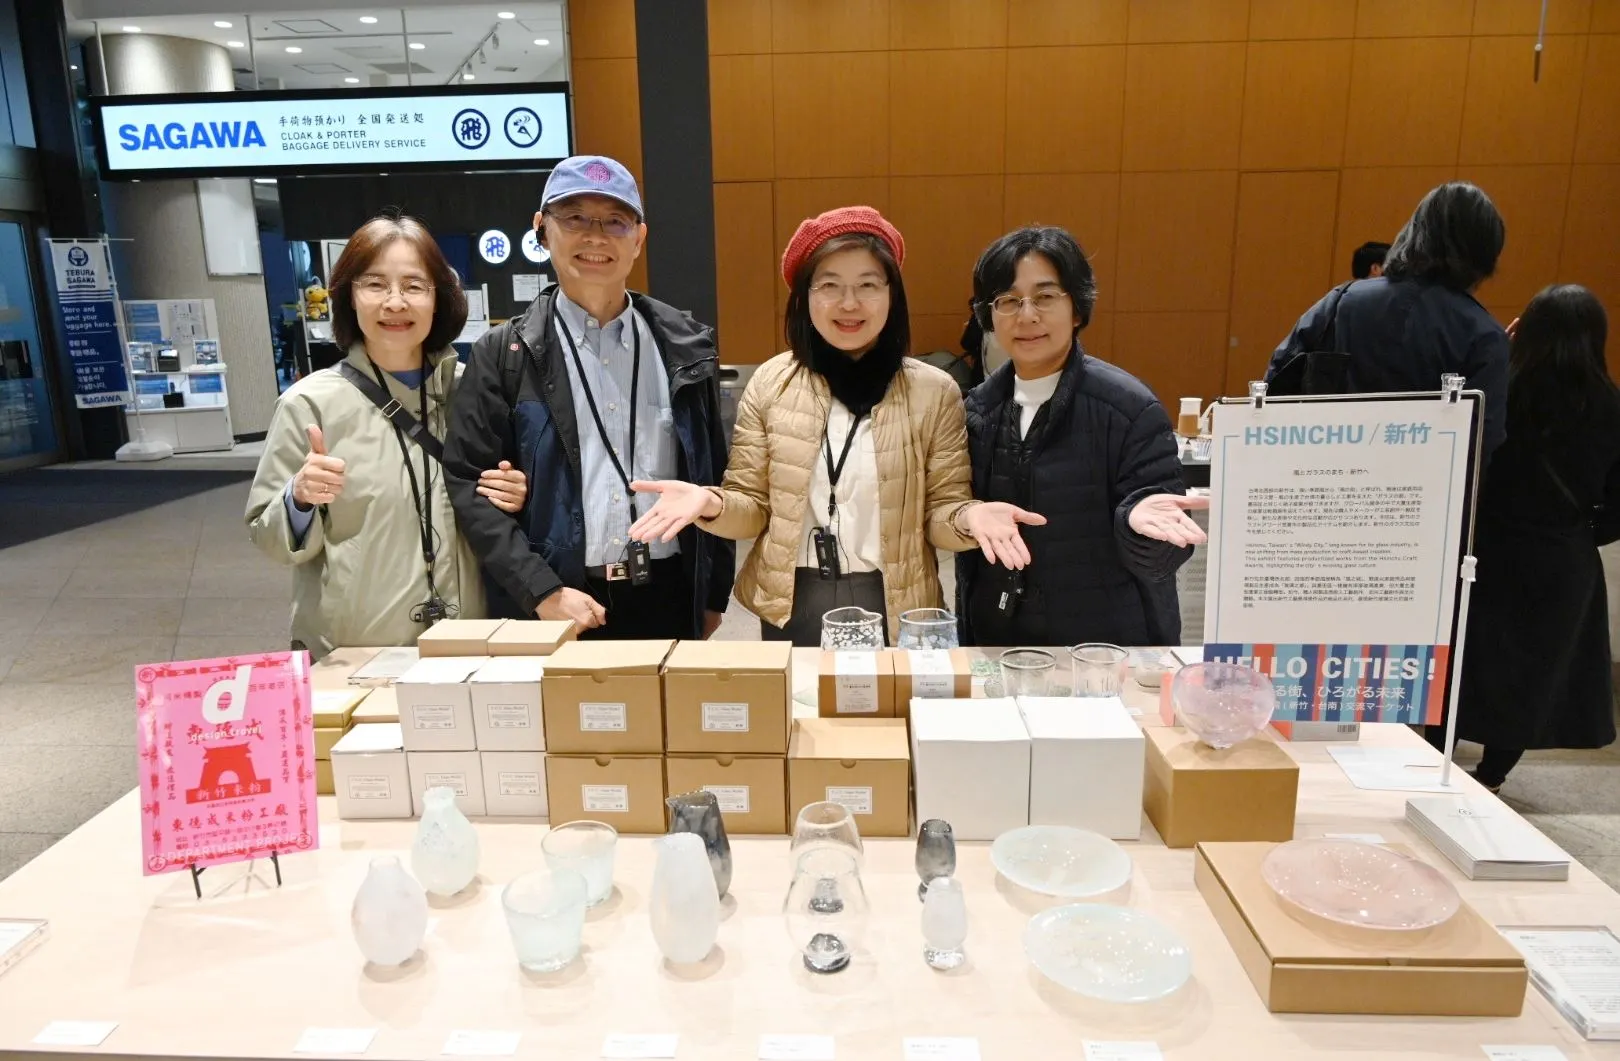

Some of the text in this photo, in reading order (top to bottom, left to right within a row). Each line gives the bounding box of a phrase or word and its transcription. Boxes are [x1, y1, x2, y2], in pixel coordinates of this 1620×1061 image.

[280, 112, 425, 127] 手荷物預かり 全国発送処
[118, 120, 267, 151] SAGAWA
[281, 130, 366, 141] CLOAK & PORTER
[282, 138, 427, 151] BAGGAGE DELIVERY SERVICE
[82, 394, 122, 405] SAGAWA
[1245, 424, 1363, 445] HSINCHU
[1384, 421, 1432, 445] 新竹
[1322, 657, 1436, 681] CITIES!
[202, 665, 252, 724] d
[191, 725, 262, 742] design travel
